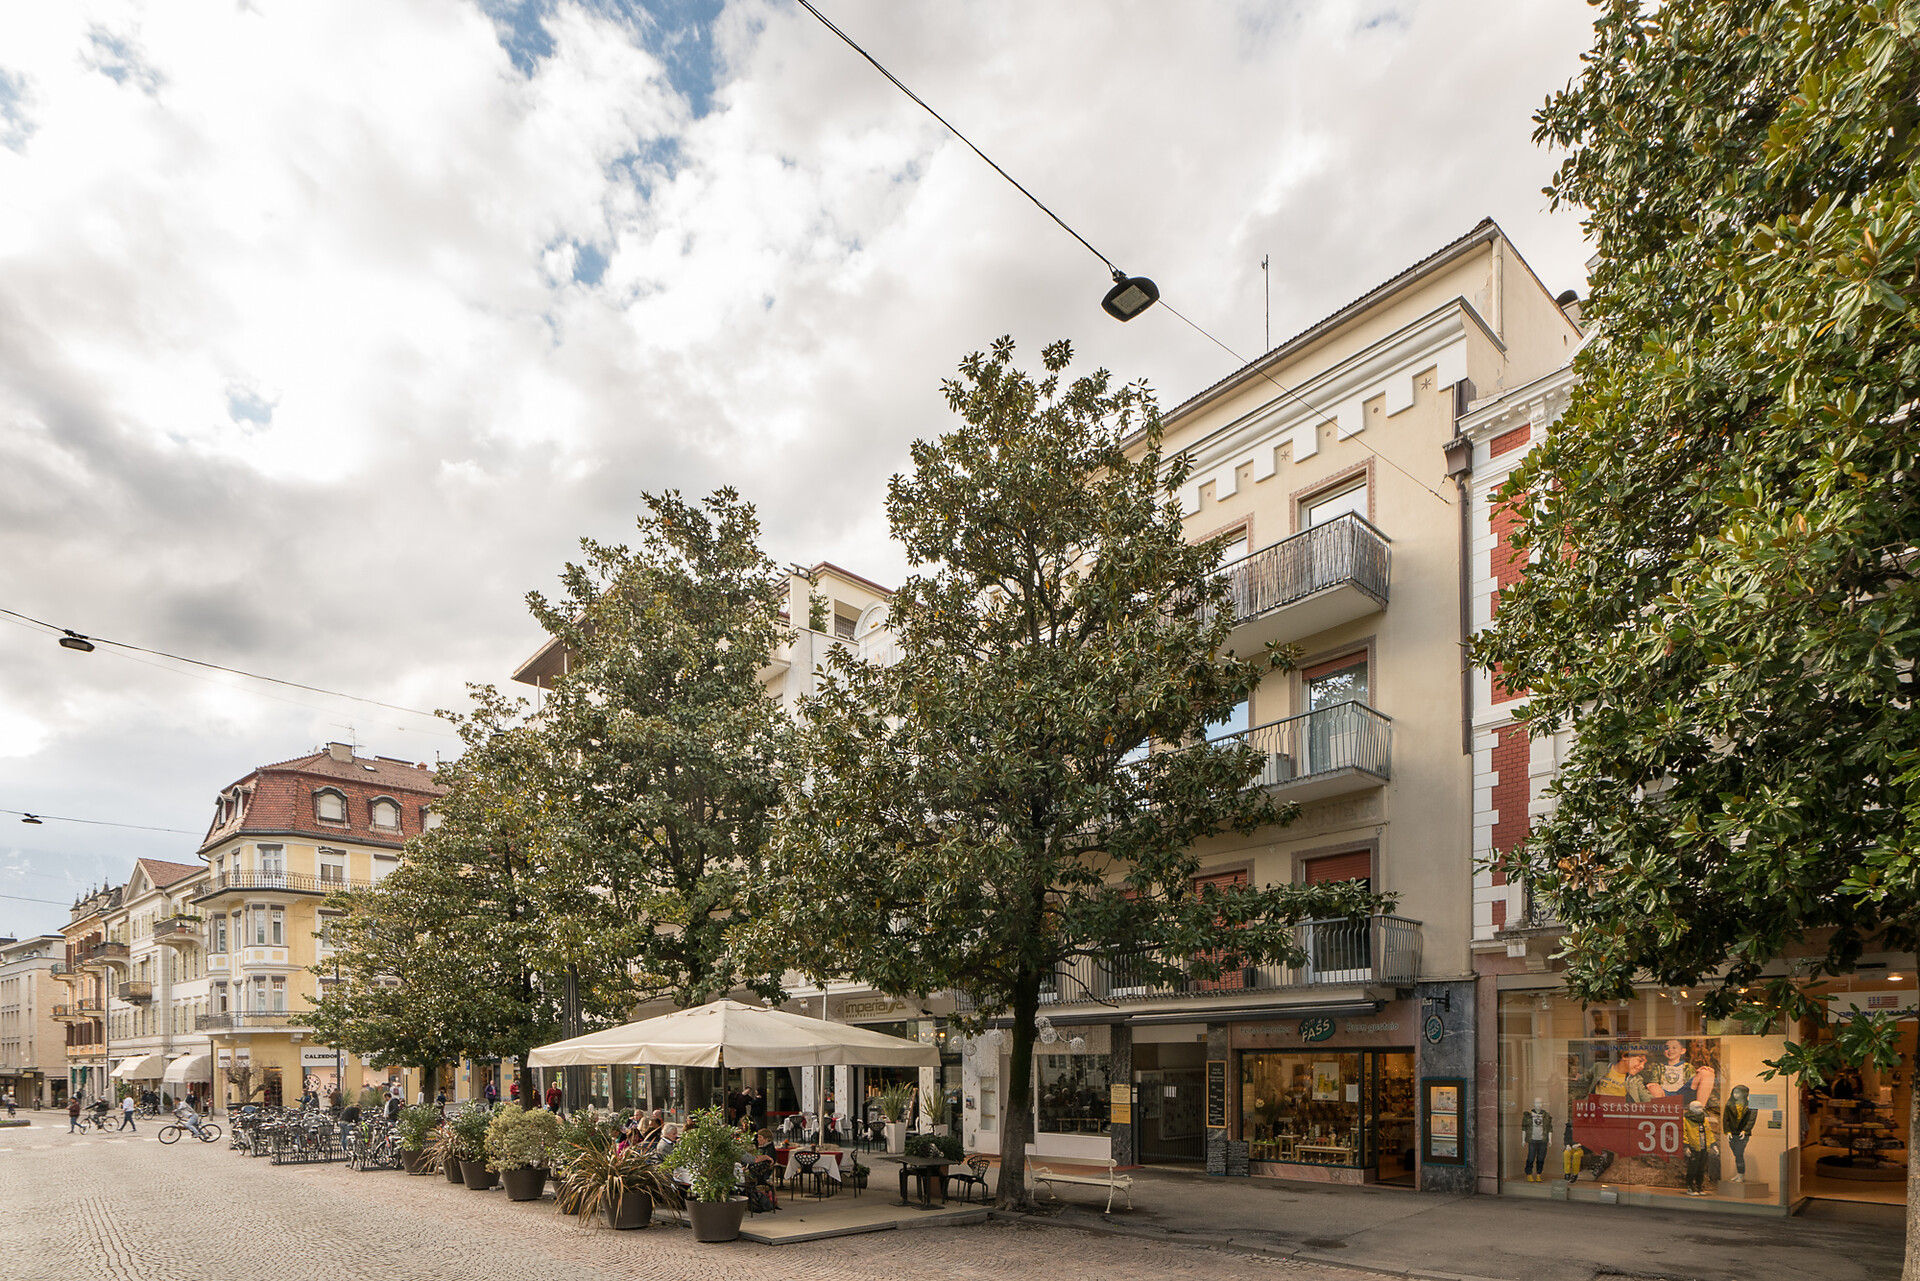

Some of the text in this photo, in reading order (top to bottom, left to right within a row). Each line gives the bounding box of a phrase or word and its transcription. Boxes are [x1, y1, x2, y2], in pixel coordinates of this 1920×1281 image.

[1302, 1018, 1330, 1043] FASS
[1576, 1102, 1680, 1114] MID-SEASON SALE
